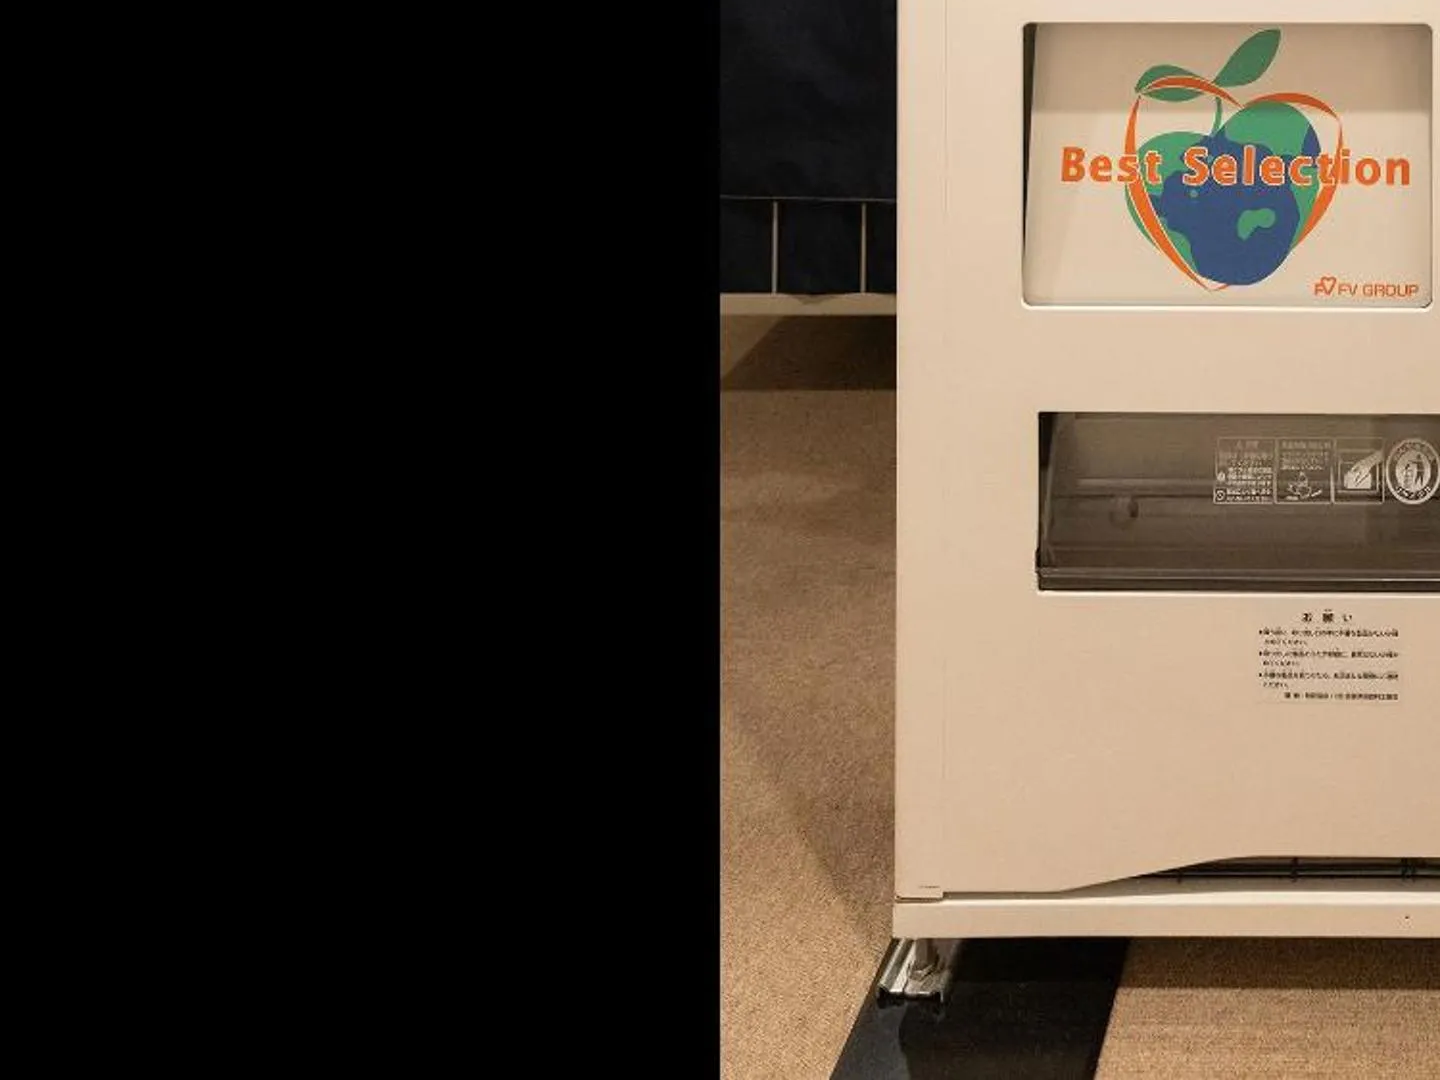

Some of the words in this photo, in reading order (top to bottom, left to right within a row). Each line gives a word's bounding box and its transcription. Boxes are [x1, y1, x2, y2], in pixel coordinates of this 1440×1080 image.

[1061, 146, 1164, 186] Best
[1183, 145, 1411, 187] Selection
[1362, 283, 1420, 298] GROUP
